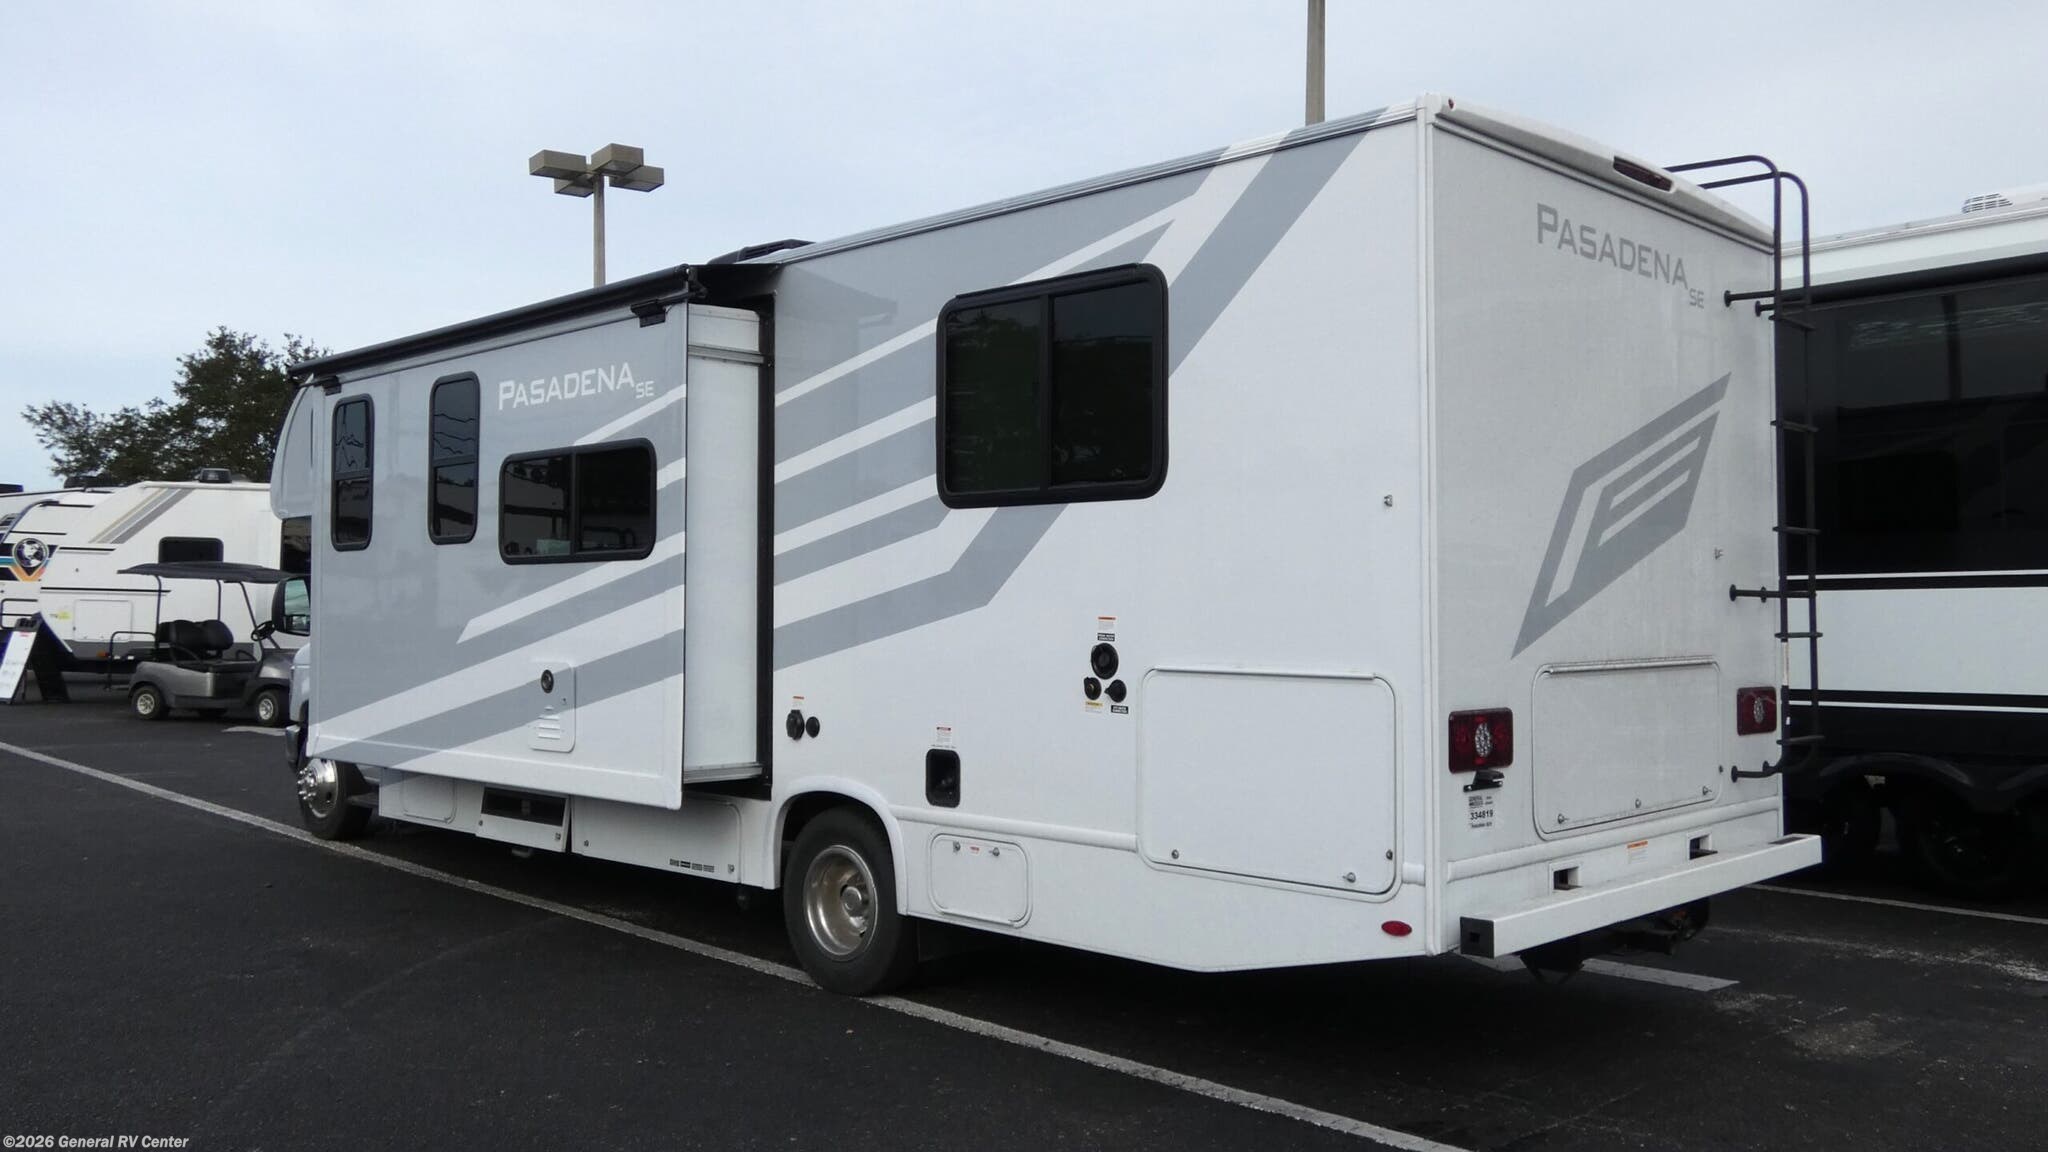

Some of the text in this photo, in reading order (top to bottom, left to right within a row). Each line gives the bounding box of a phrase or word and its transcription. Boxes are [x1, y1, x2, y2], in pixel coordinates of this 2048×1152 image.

[1537, 203, 1704, 309] PASADENA SE
[498, 362, 655, 410] PASADENA SE
